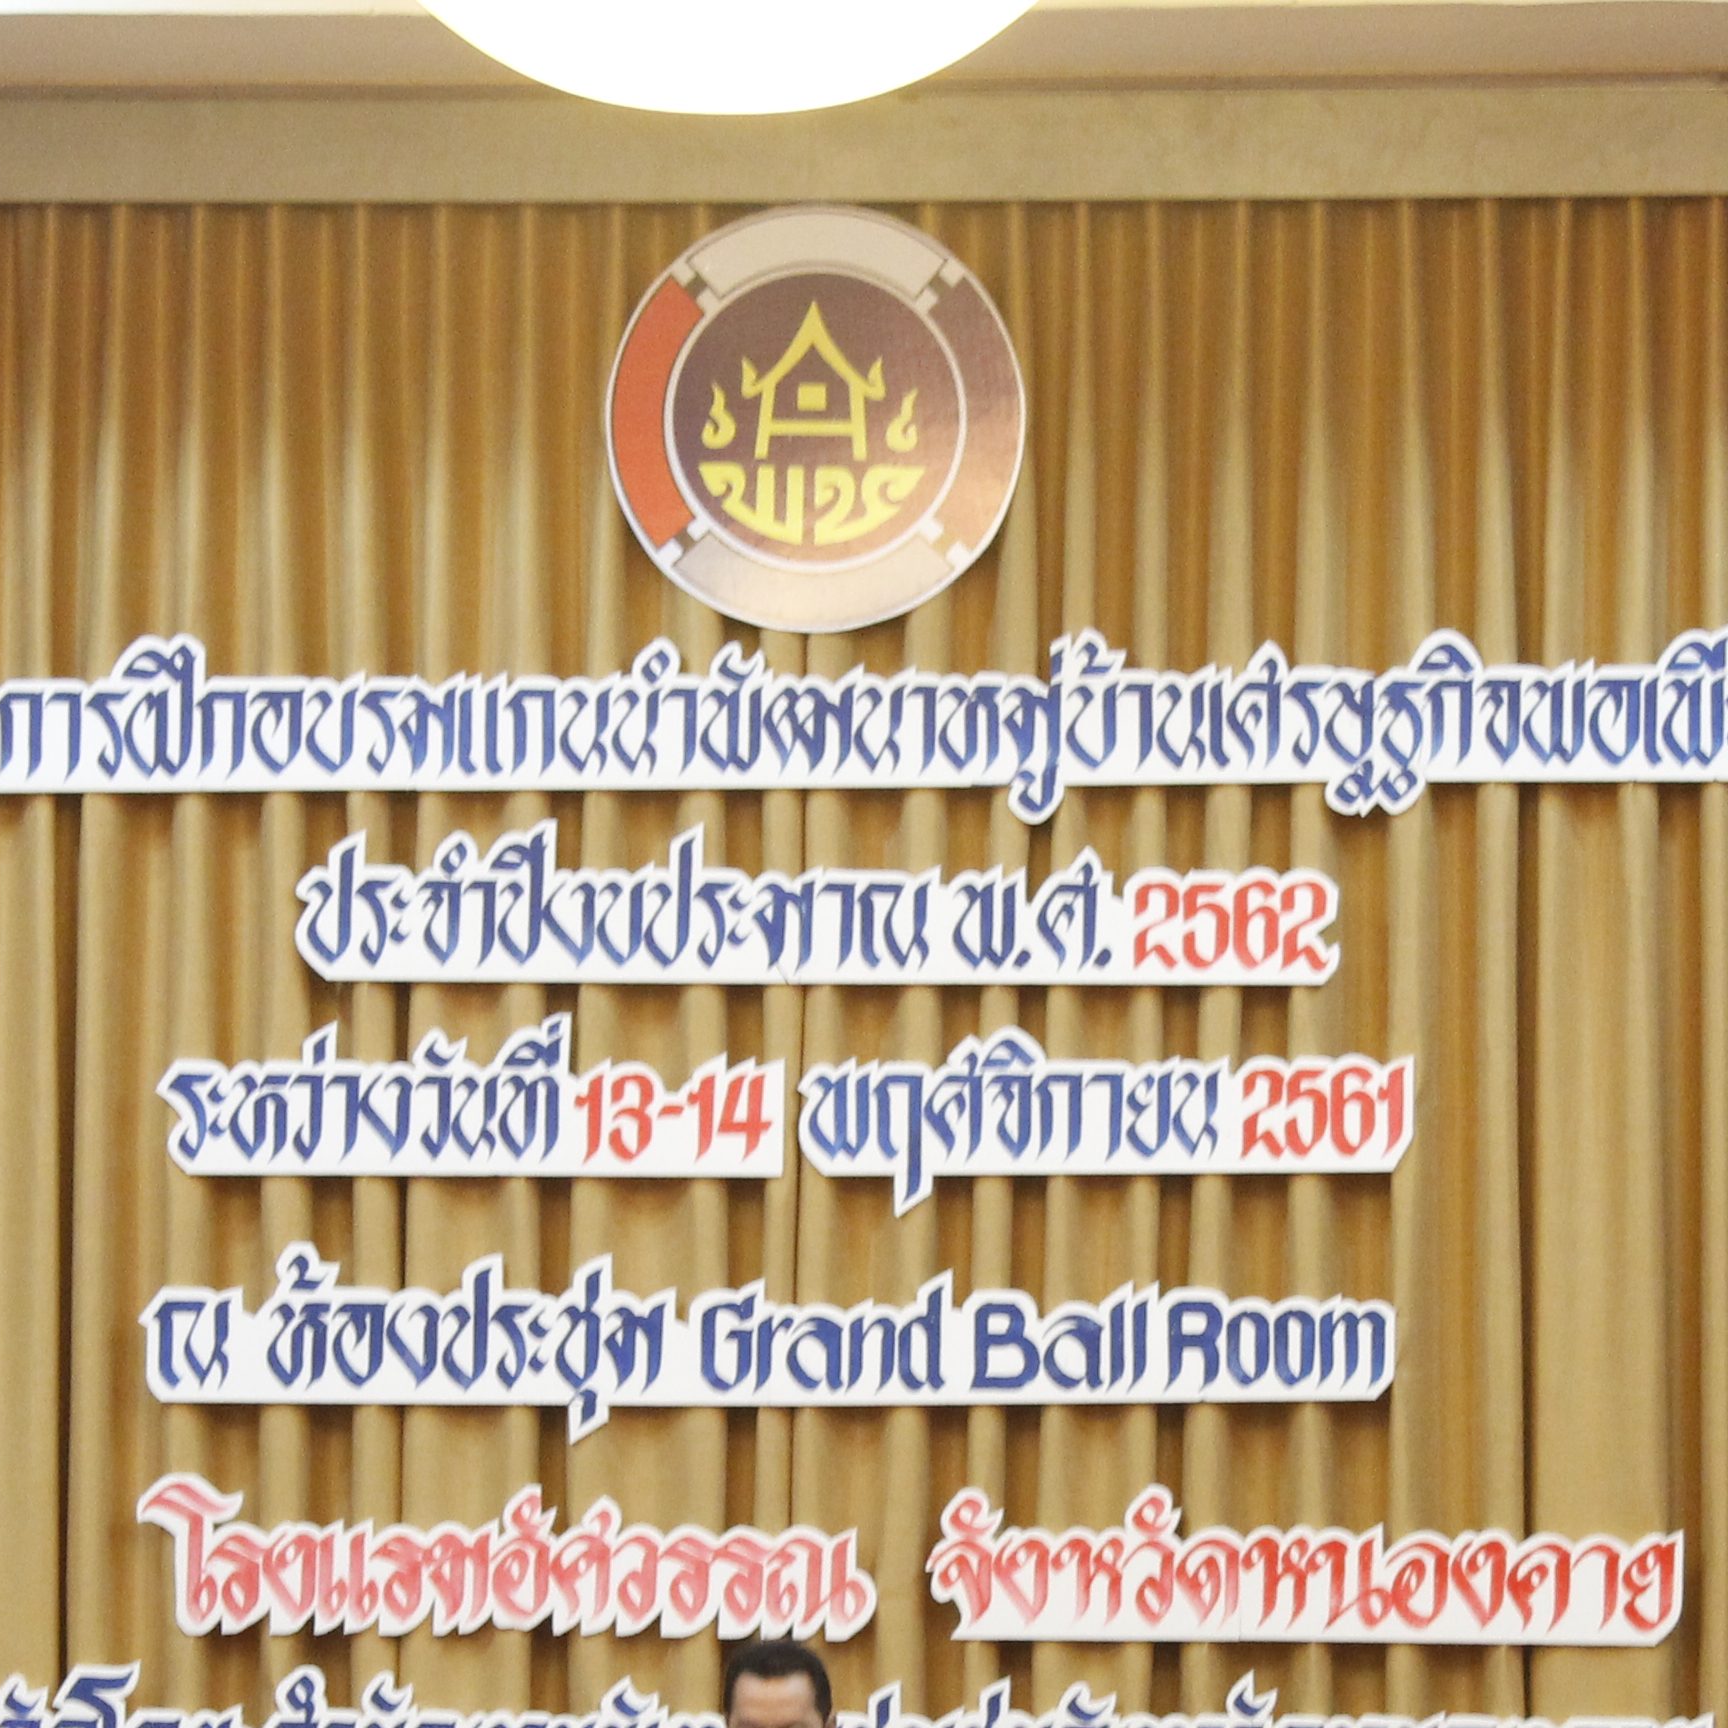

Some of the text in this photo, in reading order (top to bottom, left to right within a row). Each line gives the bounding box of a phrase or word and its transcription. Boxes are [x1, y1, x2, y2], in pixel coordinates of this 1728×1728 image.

[307, 831, 1330, 972] ประจำปีงบประมาณ พ.ศ. 2562
[808, 1038, 1220, 1200] พฤศจิกายน
[1240, 1065, 1407, 1158] 2561
[155, 1255, 1388, 1424] ณ ห้องประชุม Grand Ball Room
[932, 1495, 1678, 1634] จังหวัดหนองคาย
